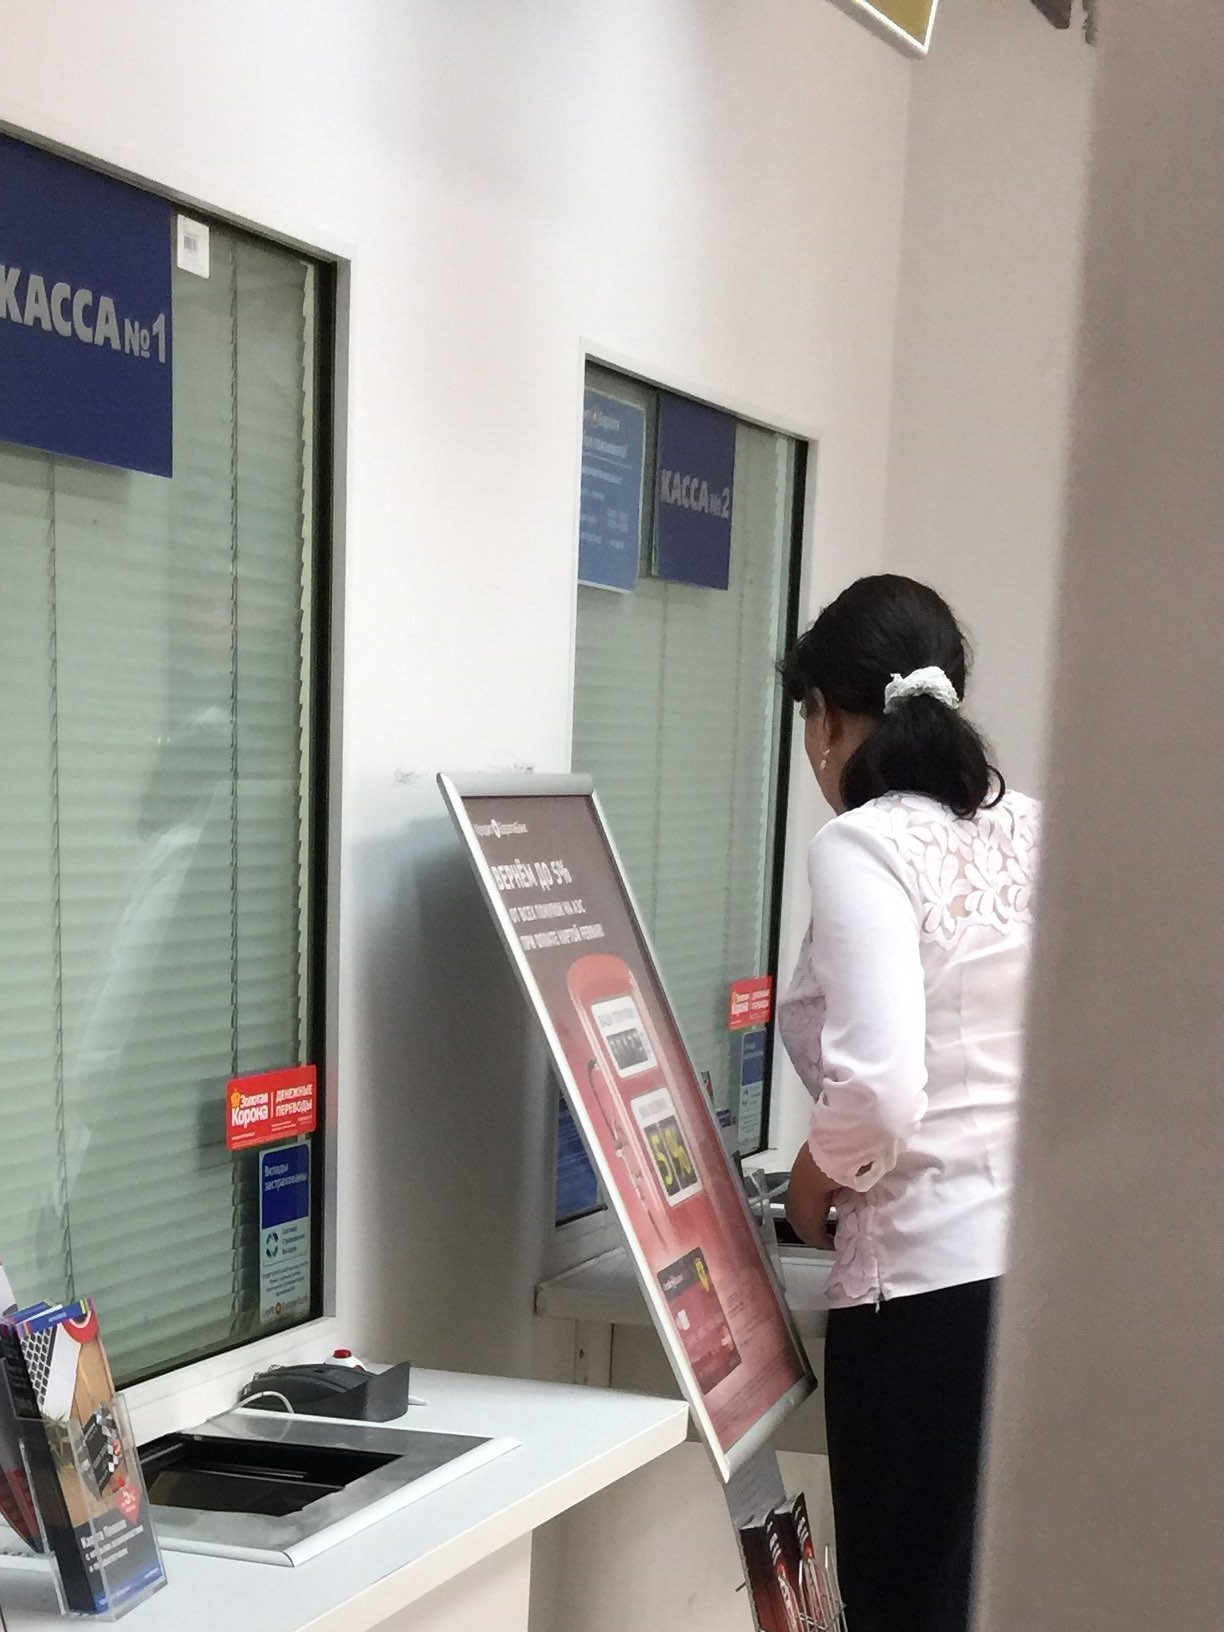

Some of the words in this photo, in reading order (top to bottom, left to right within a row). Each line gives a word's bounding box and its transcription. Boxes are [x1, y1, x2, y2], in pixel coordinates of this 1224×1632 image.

[124, 313, 166, 364] №1
[661, 468, 709, 514] КАССА
[232, 1105, 269, 1129] Корона
[276, 1098, 313, 1117] ПЕРЕВОДЫ
